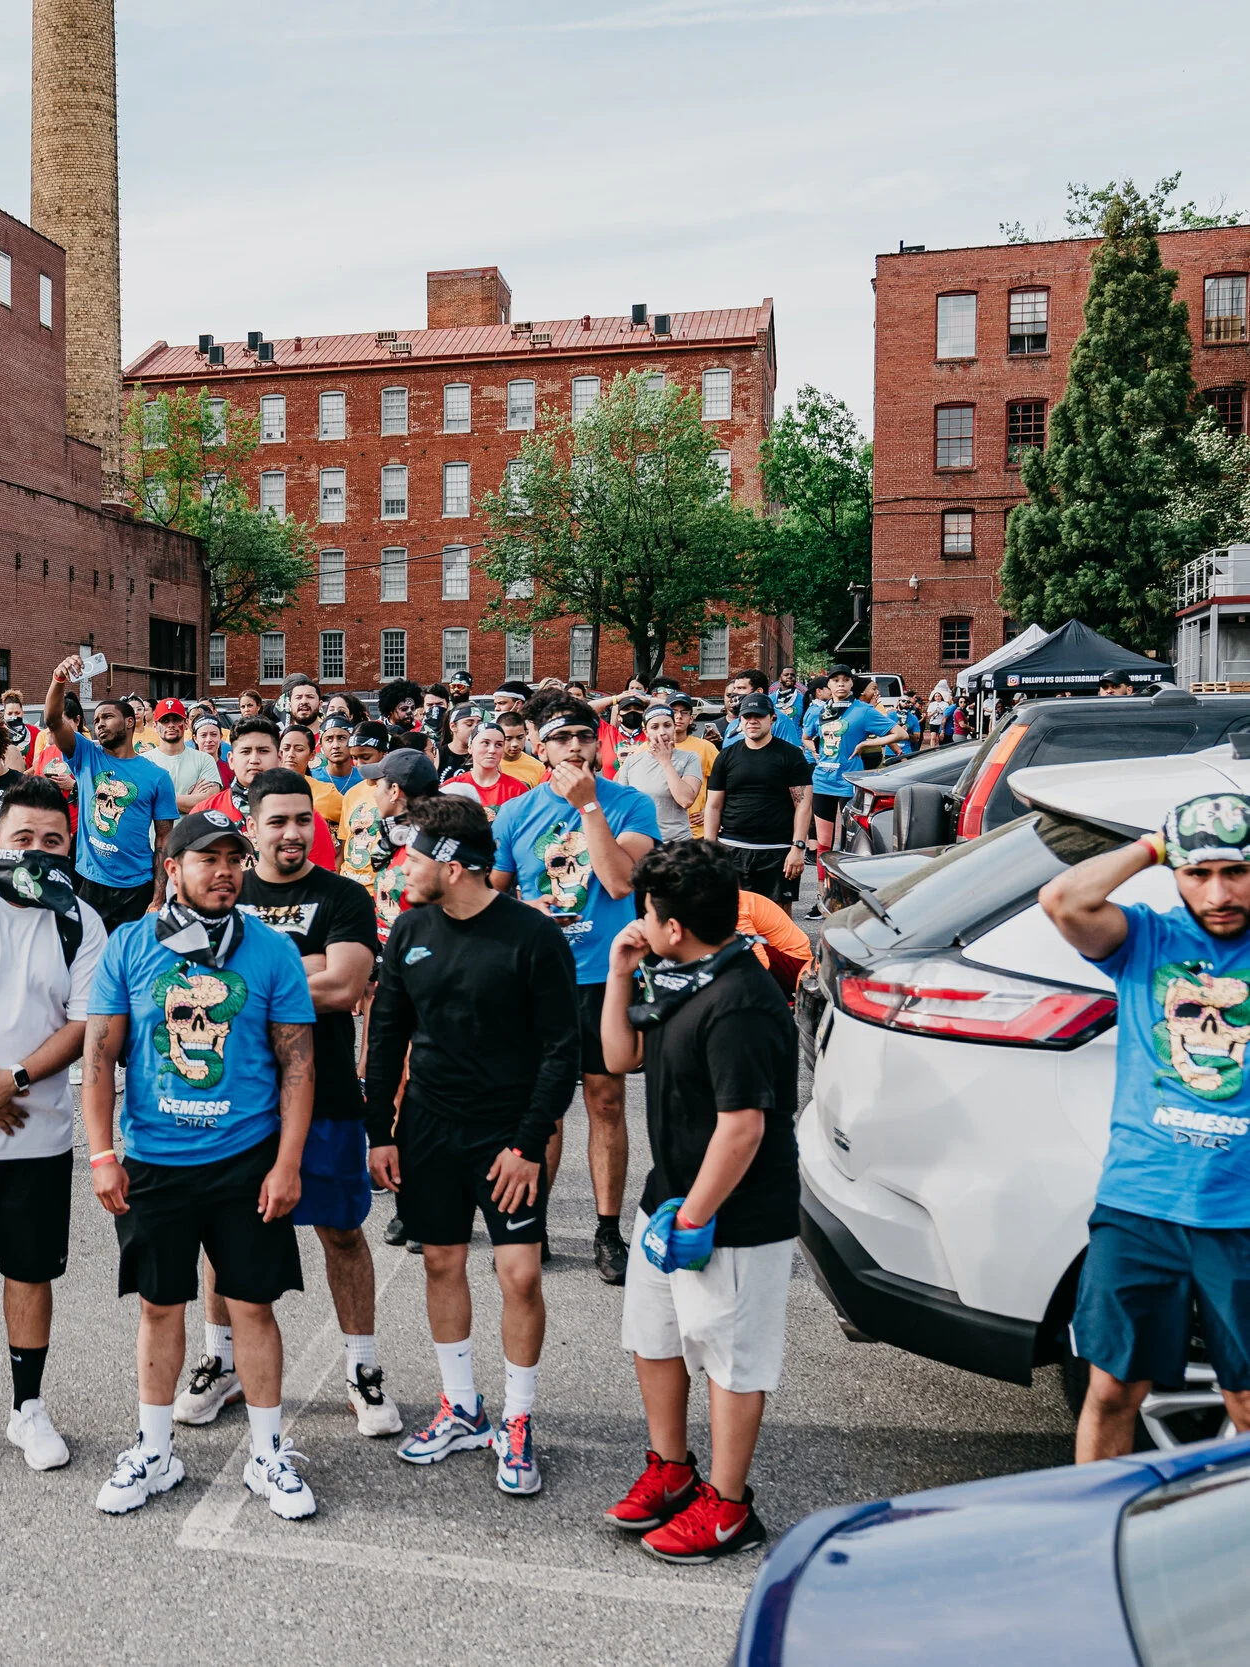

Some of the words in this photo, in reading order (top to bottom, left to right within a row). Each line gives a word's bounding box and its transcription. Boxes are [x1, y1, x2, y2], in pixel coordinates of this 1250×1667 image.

[1021, 676, 1046, 684] FOLLOW
[1064, 675, 1100, 683] INSTAGRAM
[165, 700, 175, 710] P
[158, 1098, 231, 1116] NEMESIS
[1153, 1106, 1250, 1136] NEMESIS
[1173, 1129, 1232, 1152] DTLR
